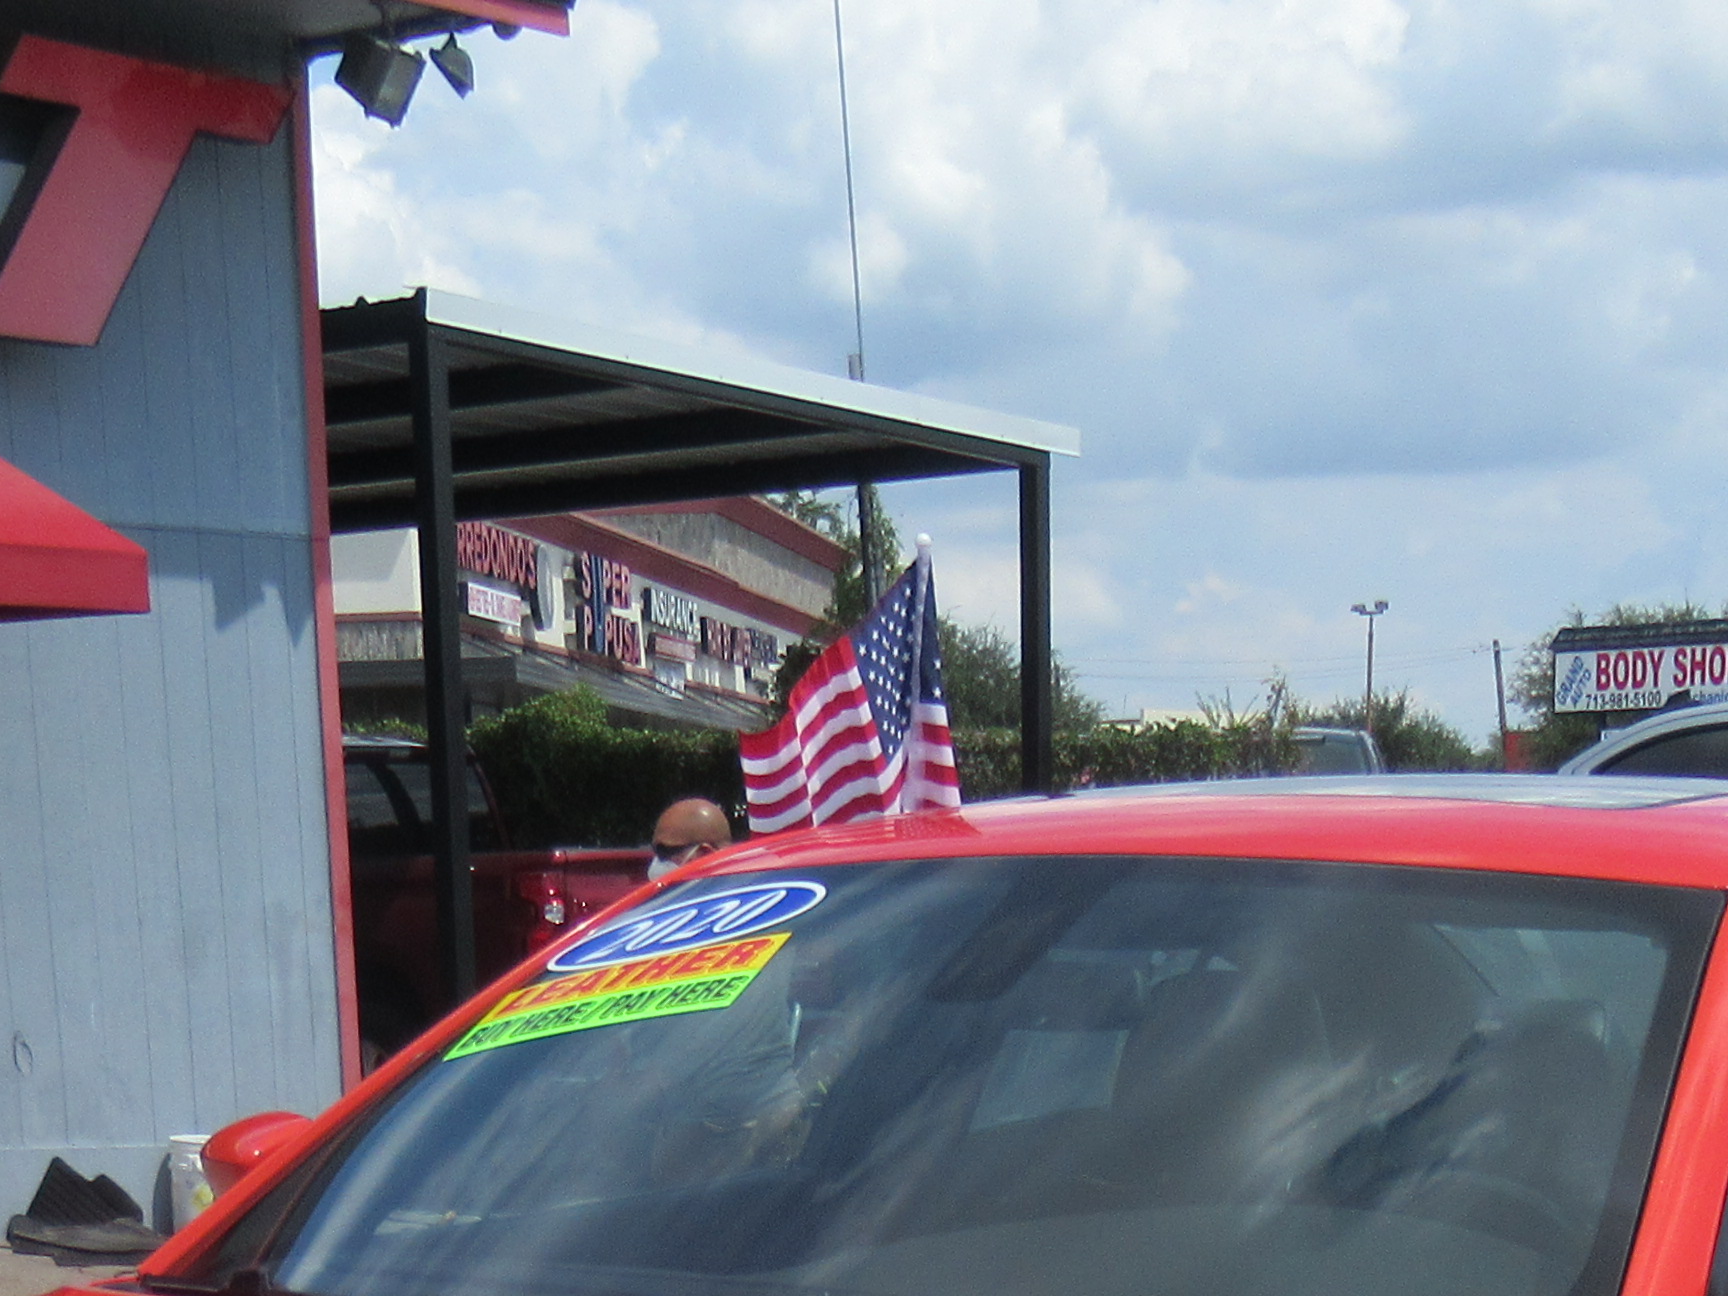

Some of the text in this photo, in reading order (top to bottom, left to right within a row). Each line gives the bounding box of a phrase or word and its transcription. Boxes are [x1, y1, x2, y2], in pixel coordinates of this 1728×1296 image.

[457, 521, 536, 590] RREDONDOS
[1585, 692, 1662, 710] 713-981-5100
[1595, 649, 1665, 692] BODY
[574, 889, 788, 964] 2020
[492, 938, 775, 1019] LEATHER
[508, 1000, 597, 1038] HERE
[599, 986, 672, 1020] PAY
[654, 975, 750, 1010] HERE
